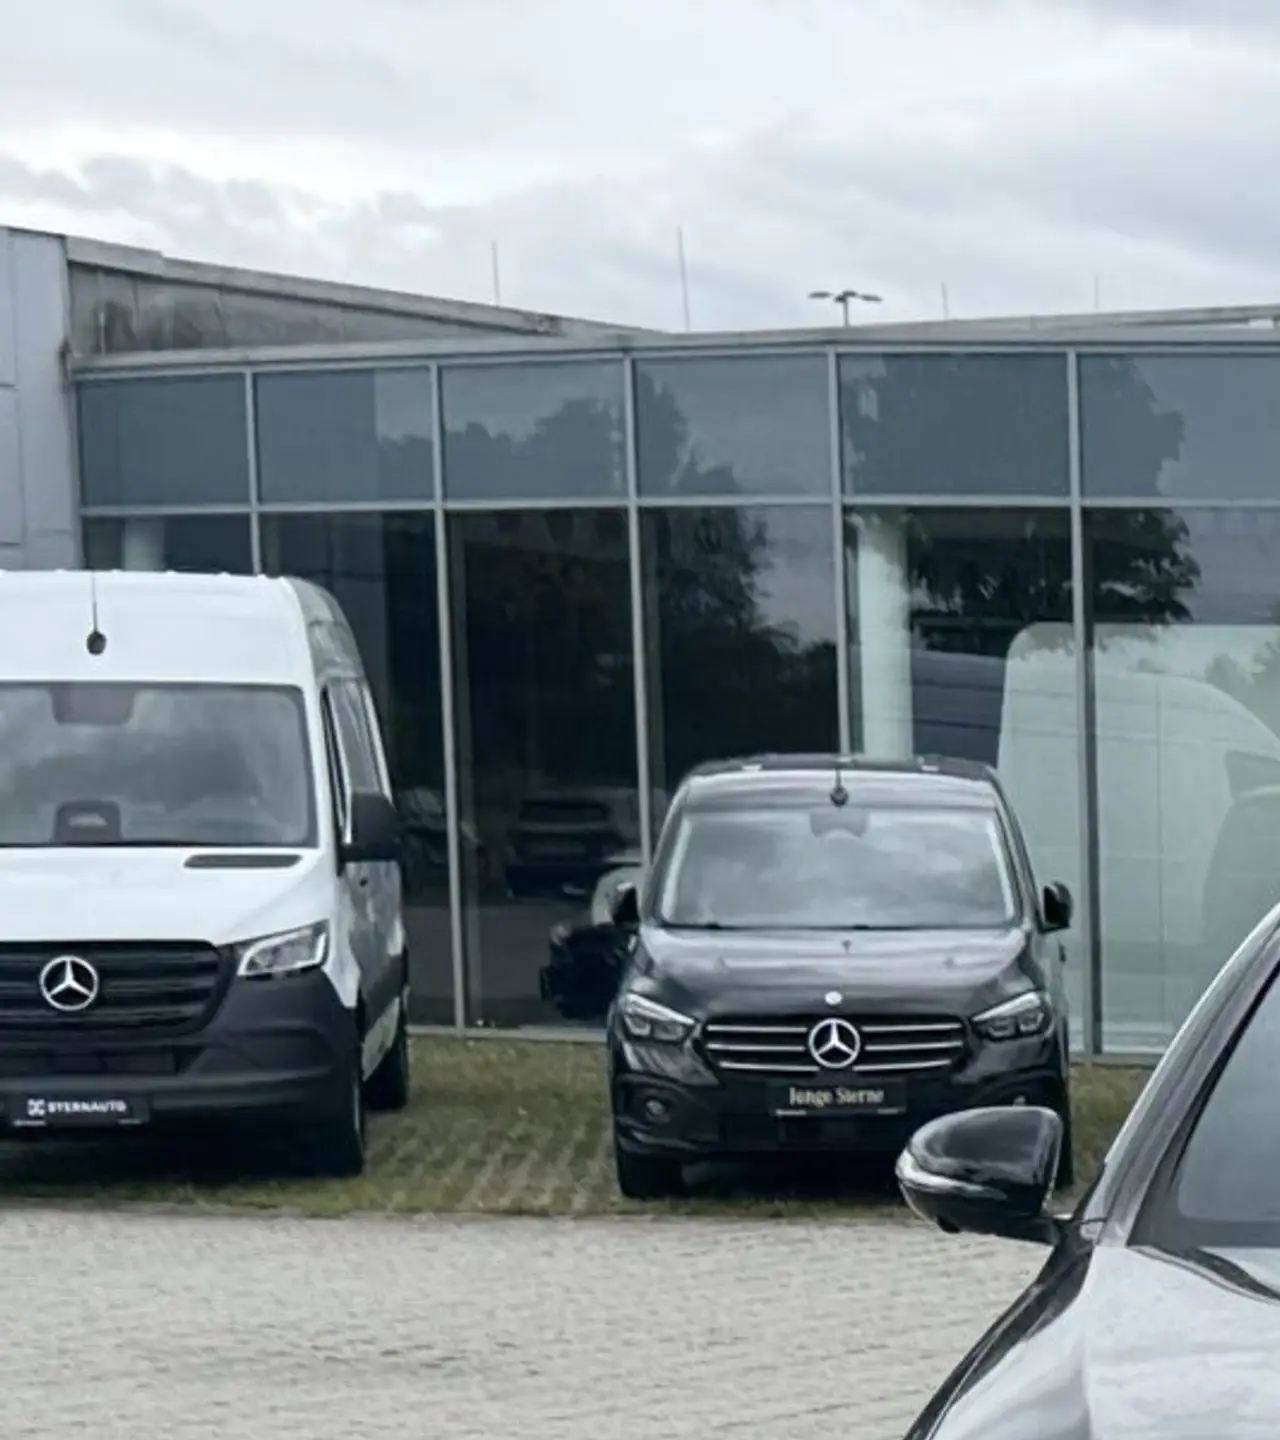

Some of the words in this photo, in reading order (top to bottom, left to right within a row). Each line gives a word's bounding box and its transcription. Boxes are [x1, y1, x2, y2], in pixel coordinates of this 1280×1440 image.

[789, 1087, 833, 1107] Junge
[836, 1087, 884, 1104] Sterne
[48, 1100, 126, 1112] STERNAUTO
